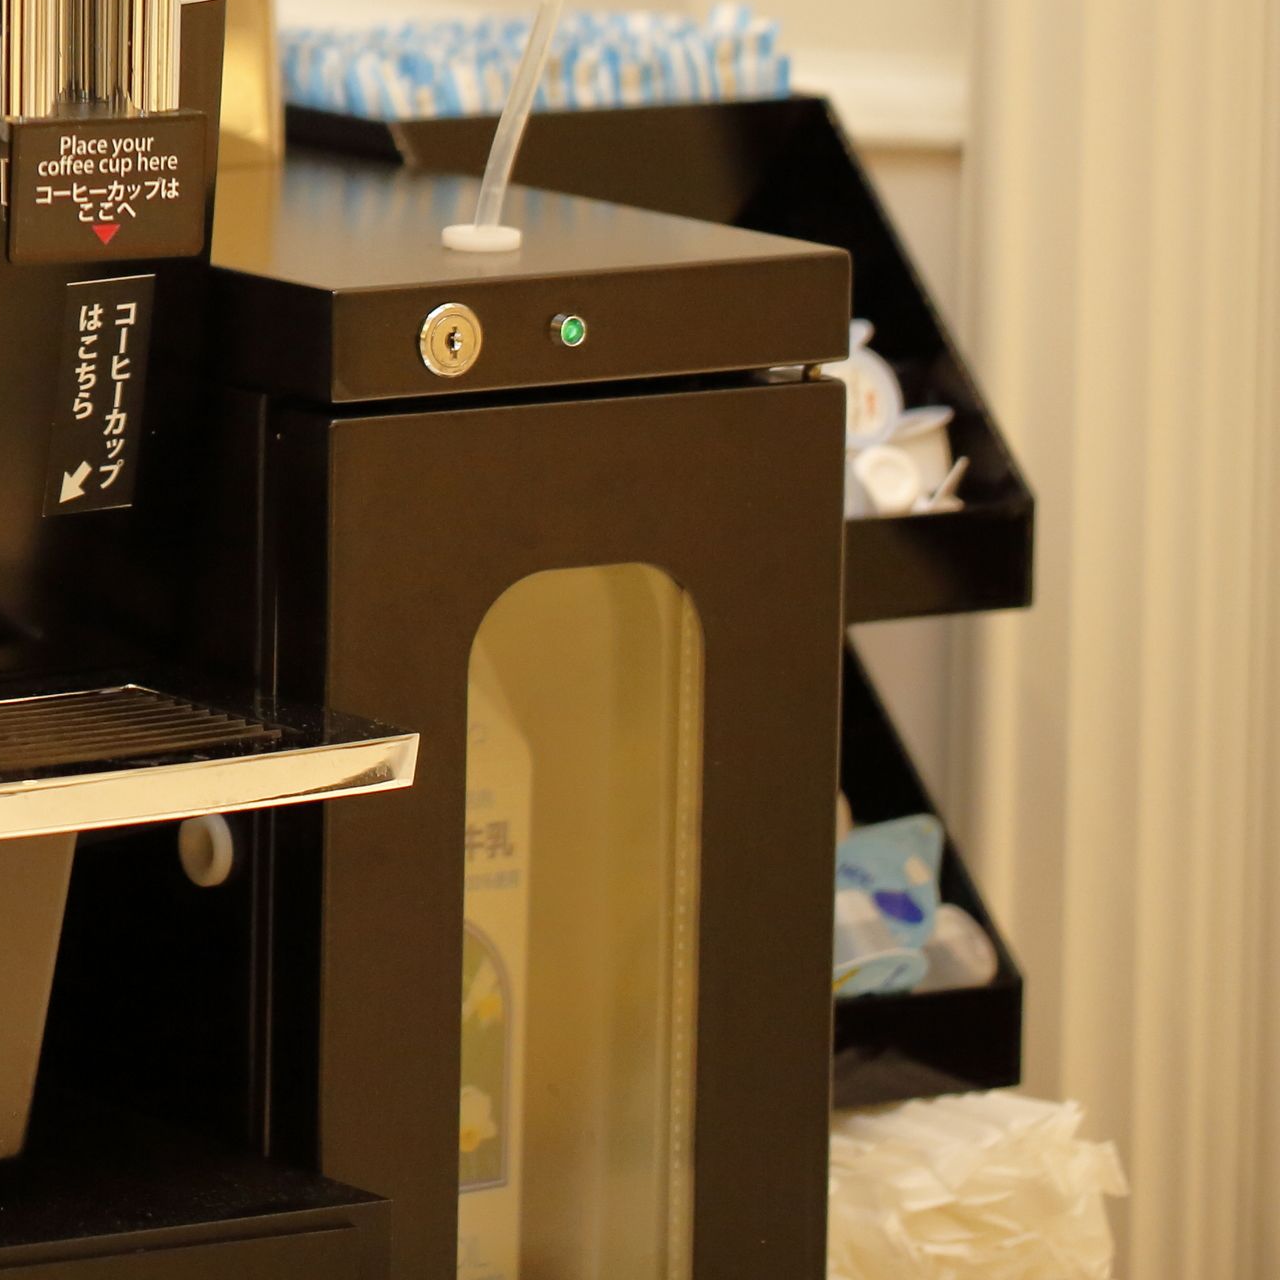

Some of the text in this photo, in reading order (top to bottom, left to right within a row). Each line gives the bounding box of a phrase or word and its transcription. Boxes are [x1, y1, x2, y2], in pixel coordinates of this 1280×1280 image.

[60, 135, 155, 158] Place your
[38, 152, 178, 177] coffee cup here
[35, 177, 180, 204] コーヒーカップは
[78, 201, 137, 223] ここへ
[72, 303, 105, 421] はこちら
[99, 303, 137, 489] コーヒーカップ
